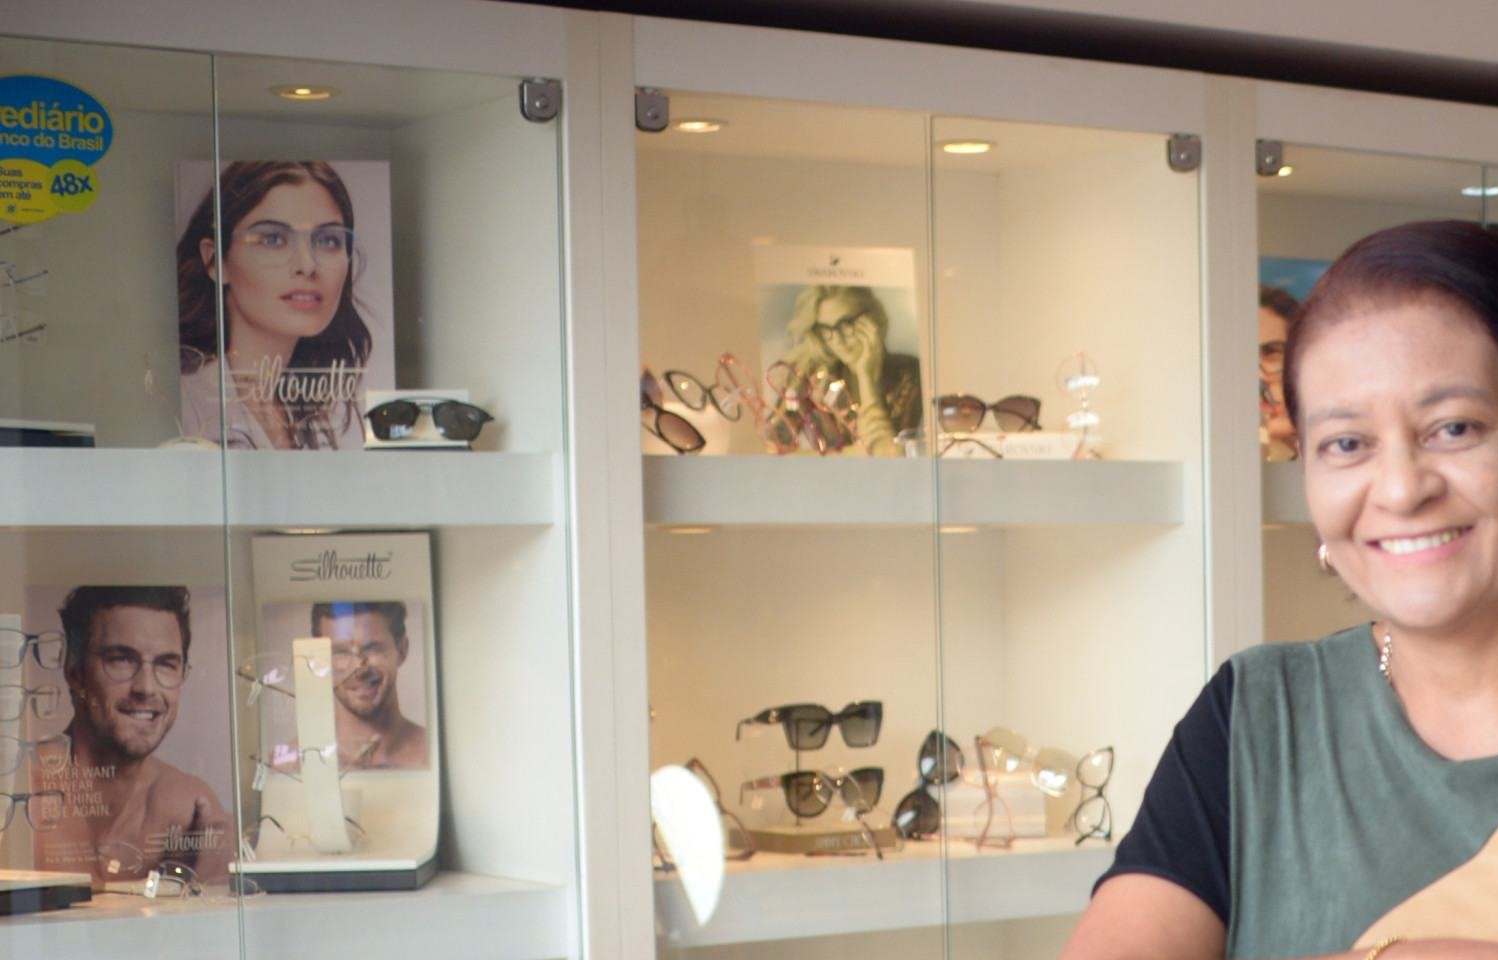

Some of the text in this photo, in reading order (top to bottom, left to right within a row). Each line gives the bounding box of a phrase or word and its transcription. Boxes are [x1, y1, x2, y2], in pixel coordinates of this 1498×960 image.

[0, 101, 104, 133] ediário
[34, 132, 55, 148] do
[58, 134, 103, 151] Brasil
[51, 172, 94, 196] 48x
[289, 549, 393, 581] Silhouette
[82, 765, 116, 779] WANT
